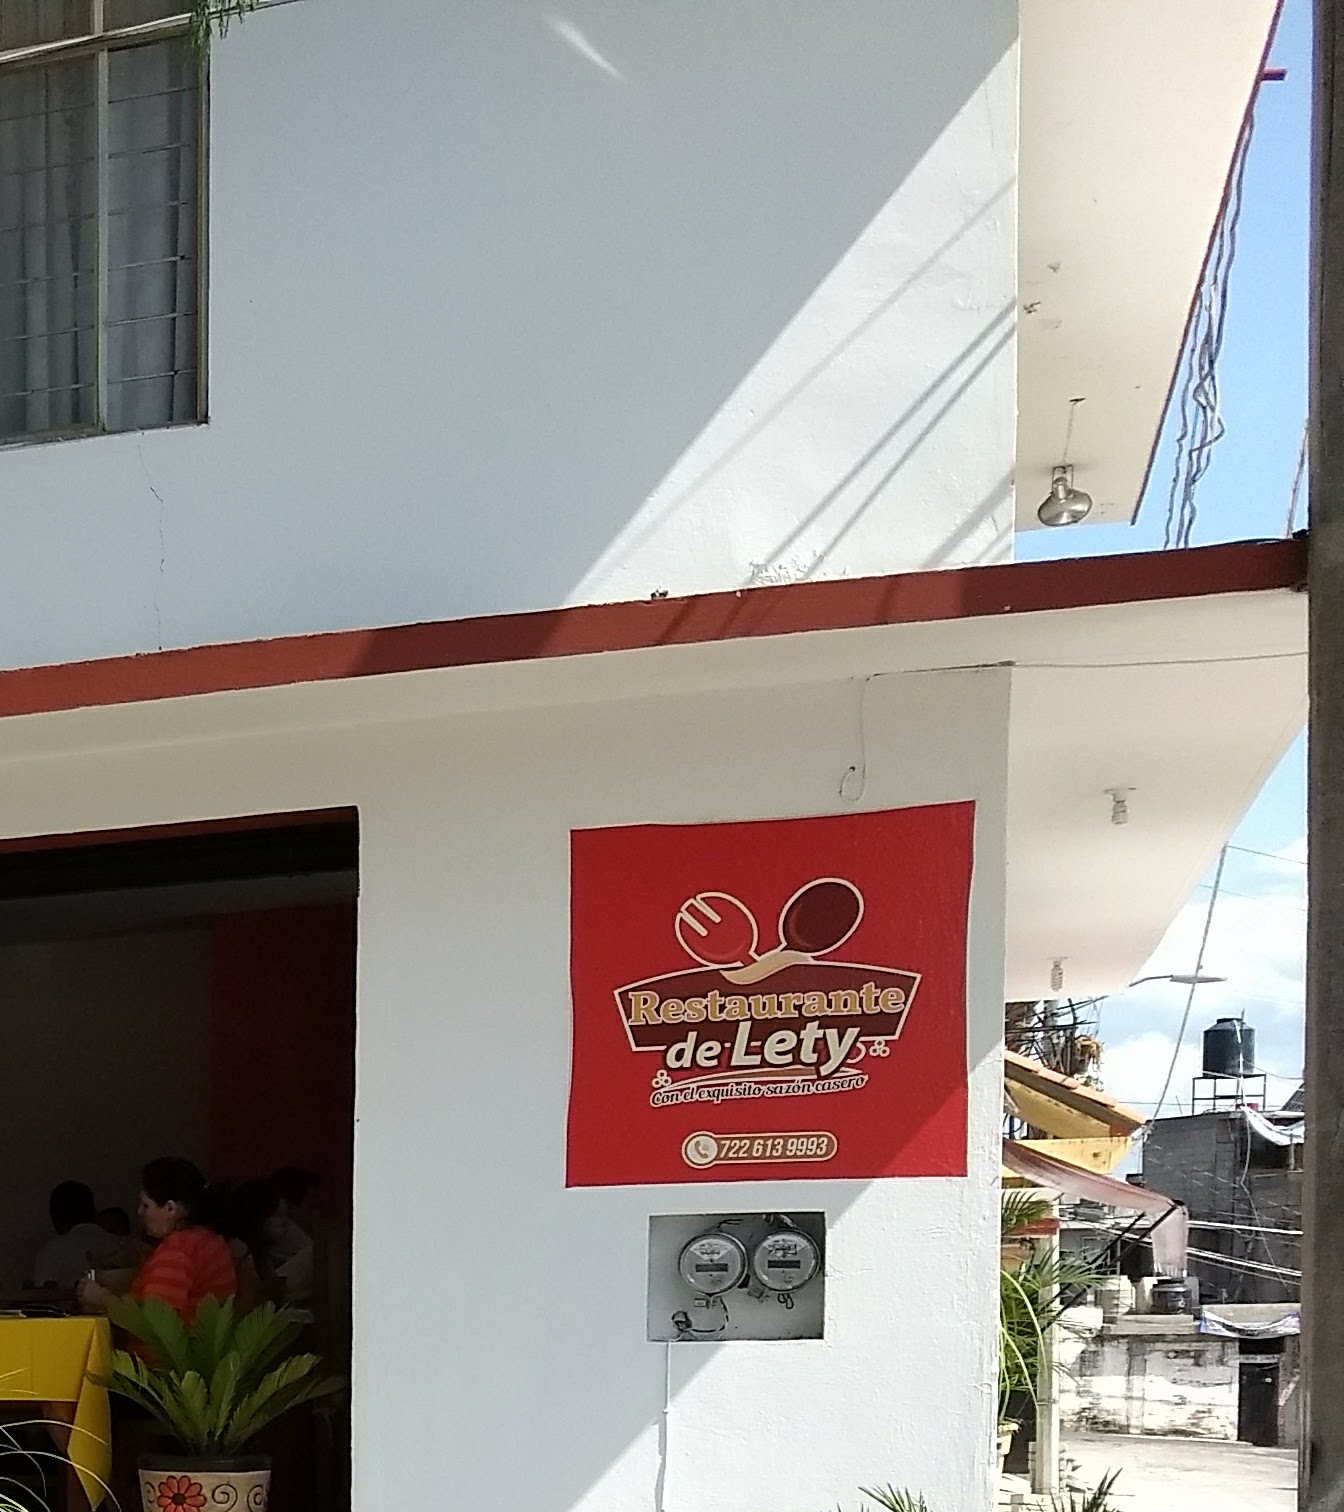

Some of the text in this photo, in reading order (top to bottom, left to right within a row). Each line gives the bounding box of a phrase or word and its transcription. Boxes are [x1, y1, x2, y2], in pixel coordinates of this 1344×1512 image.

[628, 981, 906, 1026] Restaurante
[666, 1020, 862, 1077] de Lety
[651, 1074, 868, 1106] Con el exquisito sazón casero
[719, 1136, 829, 1159] 722 613 9993
